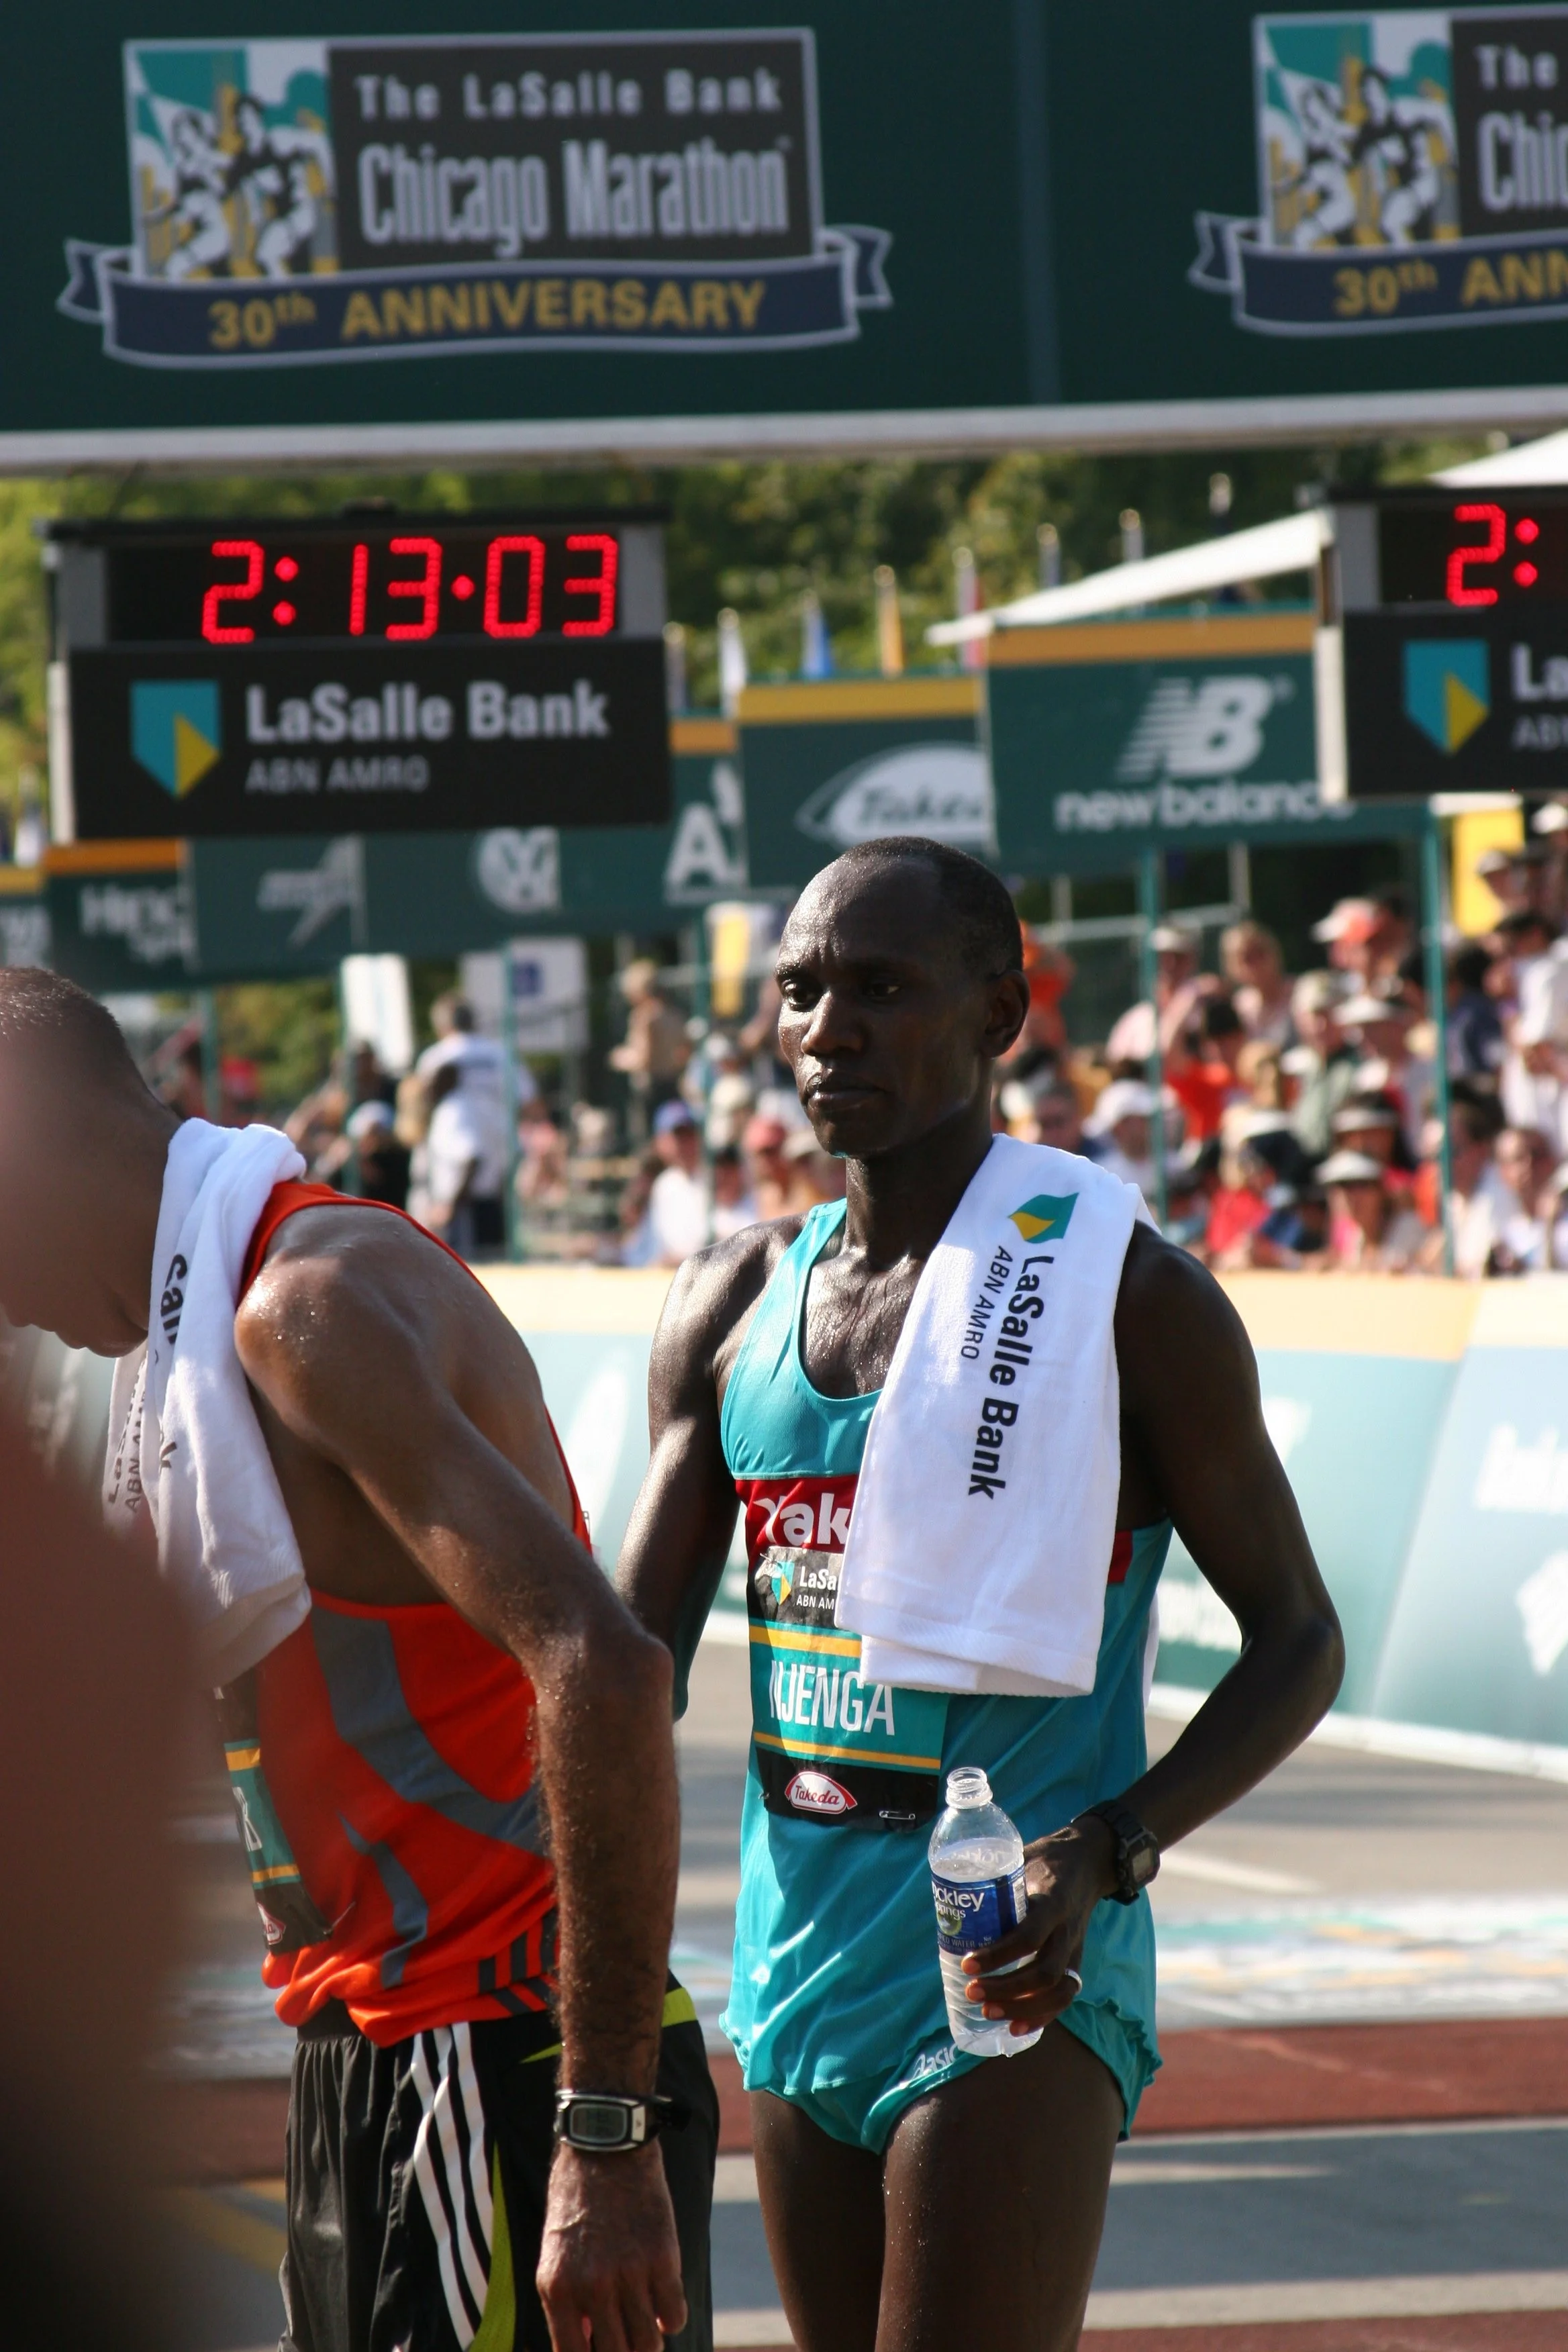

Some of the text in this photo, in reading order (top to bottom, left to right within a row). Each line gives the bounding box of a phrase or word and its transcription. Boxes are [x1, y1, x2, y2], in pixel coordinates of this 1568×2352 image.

[356, 68, 782, 120] The LaSalle Bank
[1474, 44, 1559, 91] The
[357, 138, 791, 260] Chicago Marathon
[207, 280, 767, 349] 30th ANNIVERSARY
[1333, 259, 1438, 316] 30th
[245, 677, 610, 744] LaSalle Bank
[1513, 713, 1568, 751] AB
[246, 754, 430, 795] ABN AMRO
[1054, 788, 1153, 832] new
[960, 1245, 1014, 1361] ABN AMRO
[967, 1255, 1054, 1500] LaSalle Bank
[796, 1594, 817, 1608] ABN
[769, 1659, 895, 1736] NJENGA
[796, 1785, 840, 1806] Takeda
